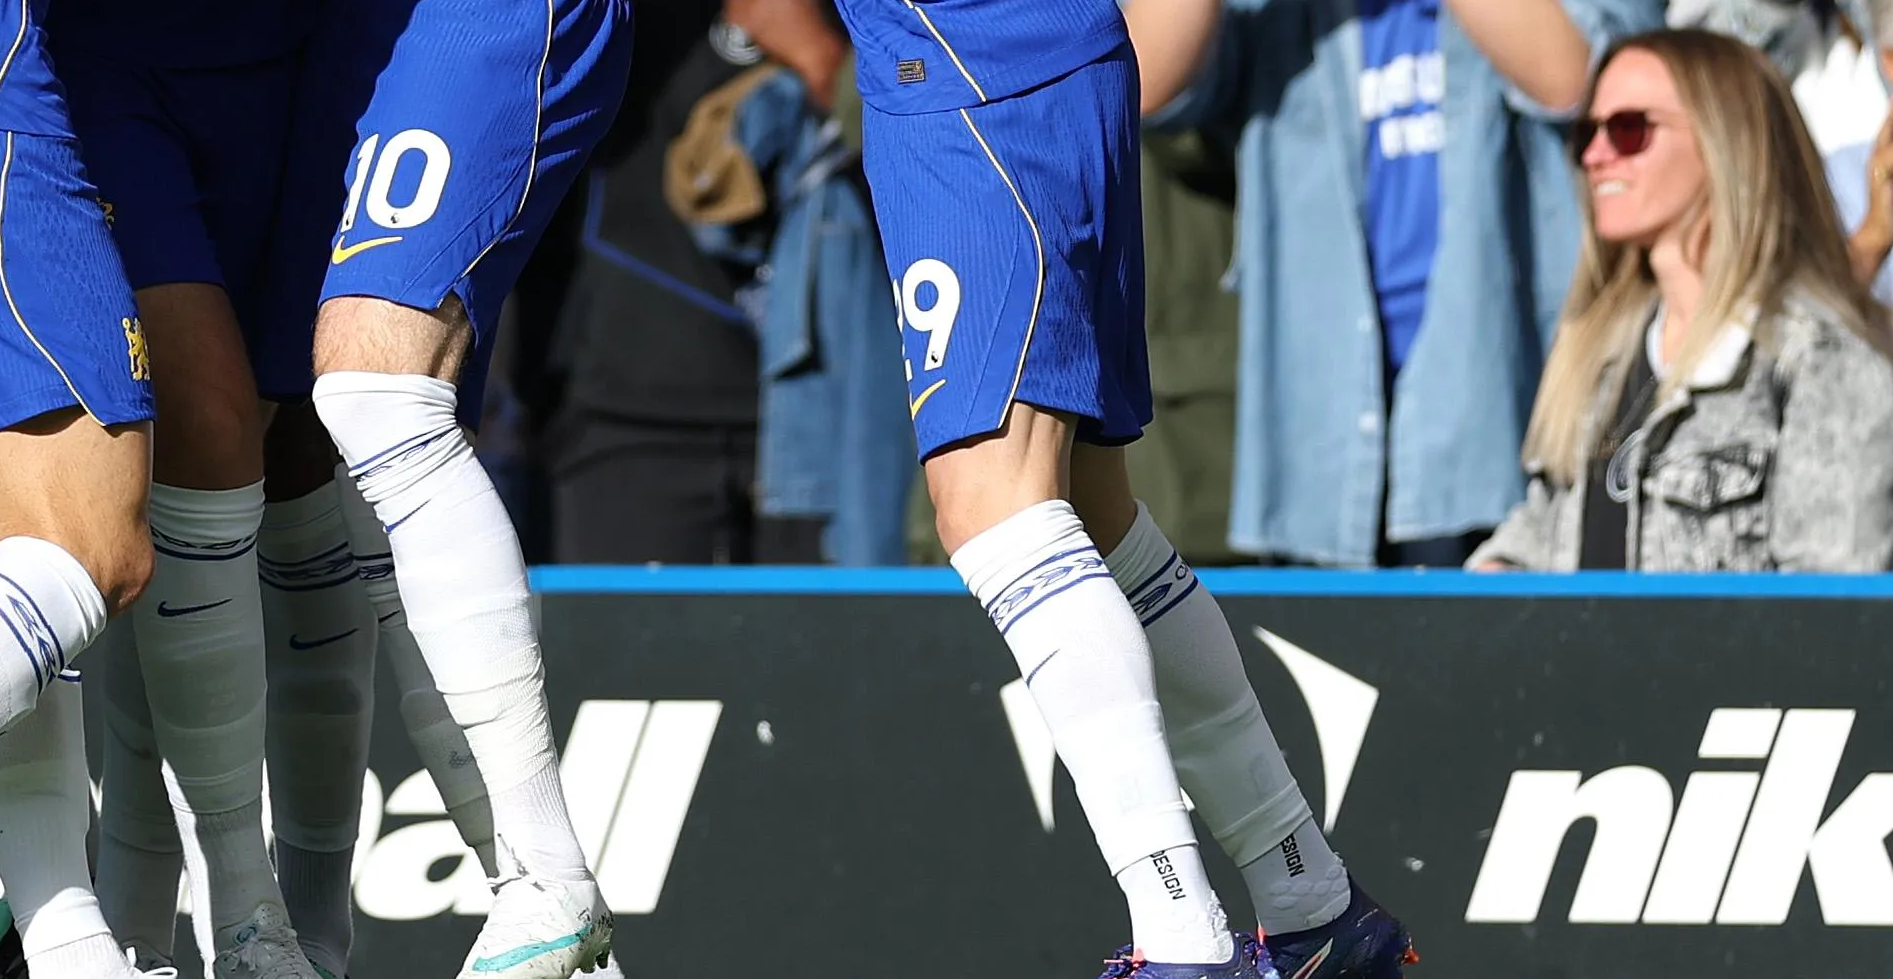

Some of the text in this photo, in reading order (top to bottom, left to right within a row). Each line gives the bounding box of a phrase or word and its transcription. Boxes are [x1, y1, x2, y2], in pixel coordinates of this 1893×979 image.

[339, 128, 451, 232] 10
[892, 258, 961, 382] 9
[1149, 849, 1187, 900] DESIGN
[1280, 833, 1306, 878] ESIGN
